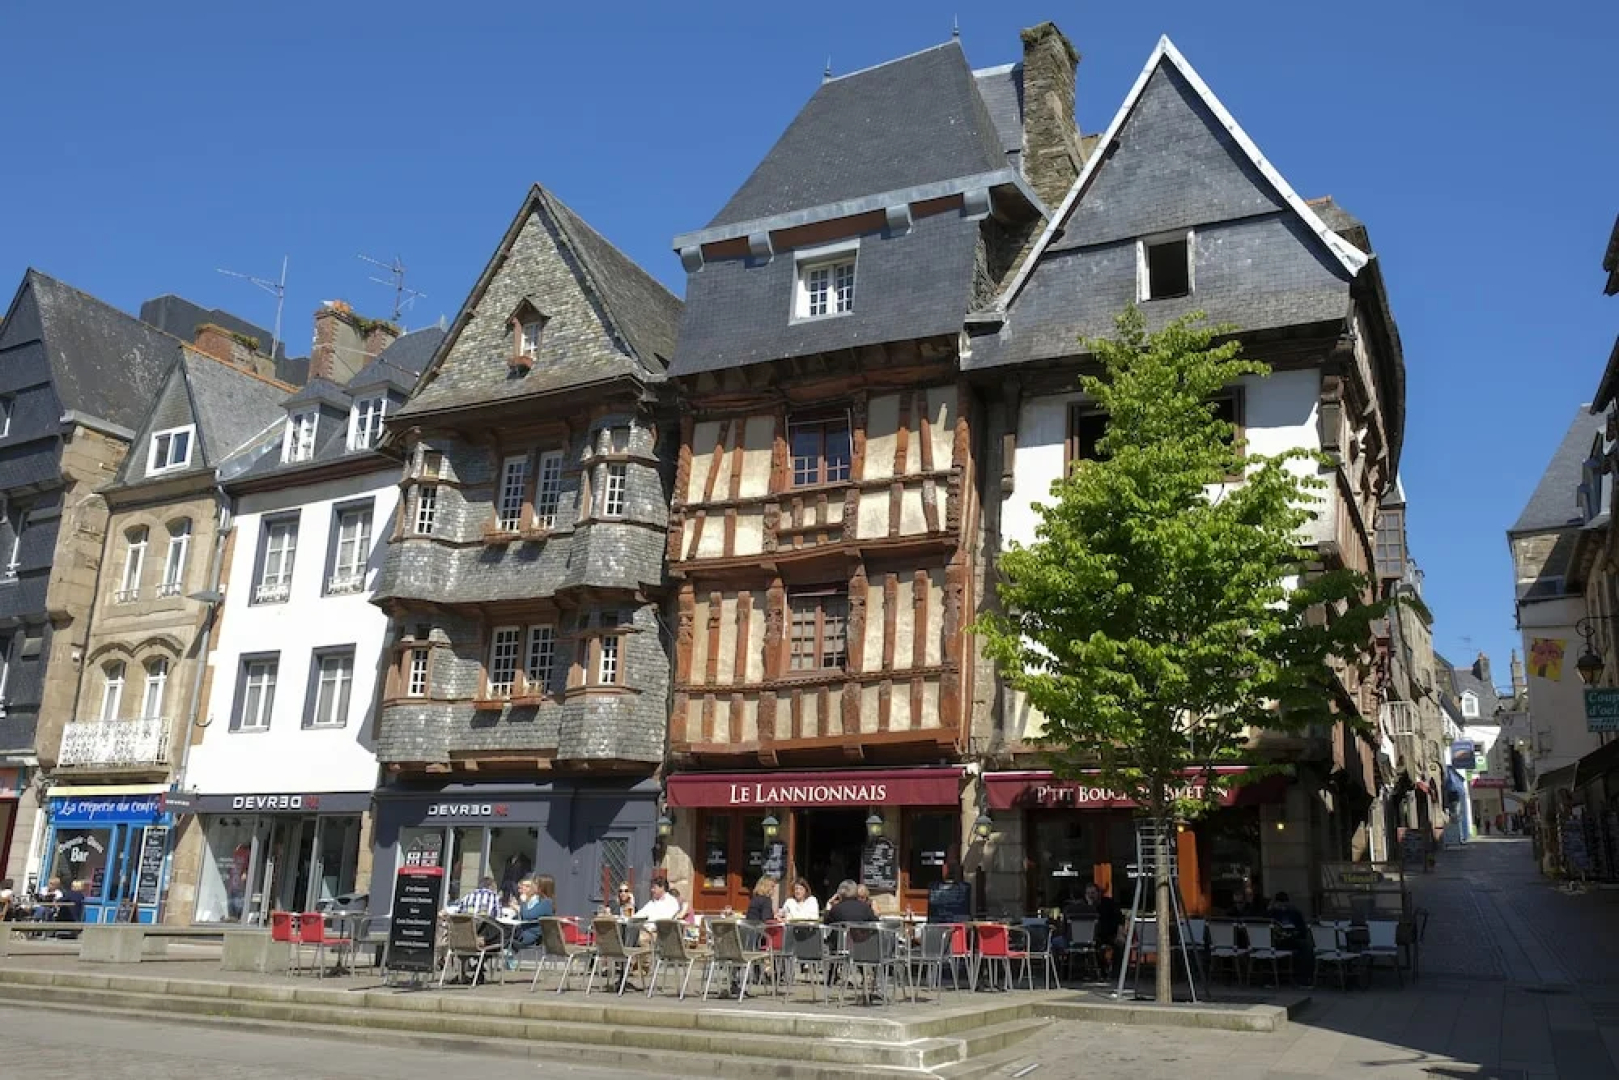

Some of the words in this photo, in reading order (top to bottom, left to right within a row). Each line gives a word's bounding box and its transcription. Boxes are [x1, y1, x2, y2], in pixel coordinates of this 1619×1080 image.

[730, 784, 750, 804] LE
[756, 784, 886, 803] LANNIONNAIS
[71, 846, 89, 862] Bar
